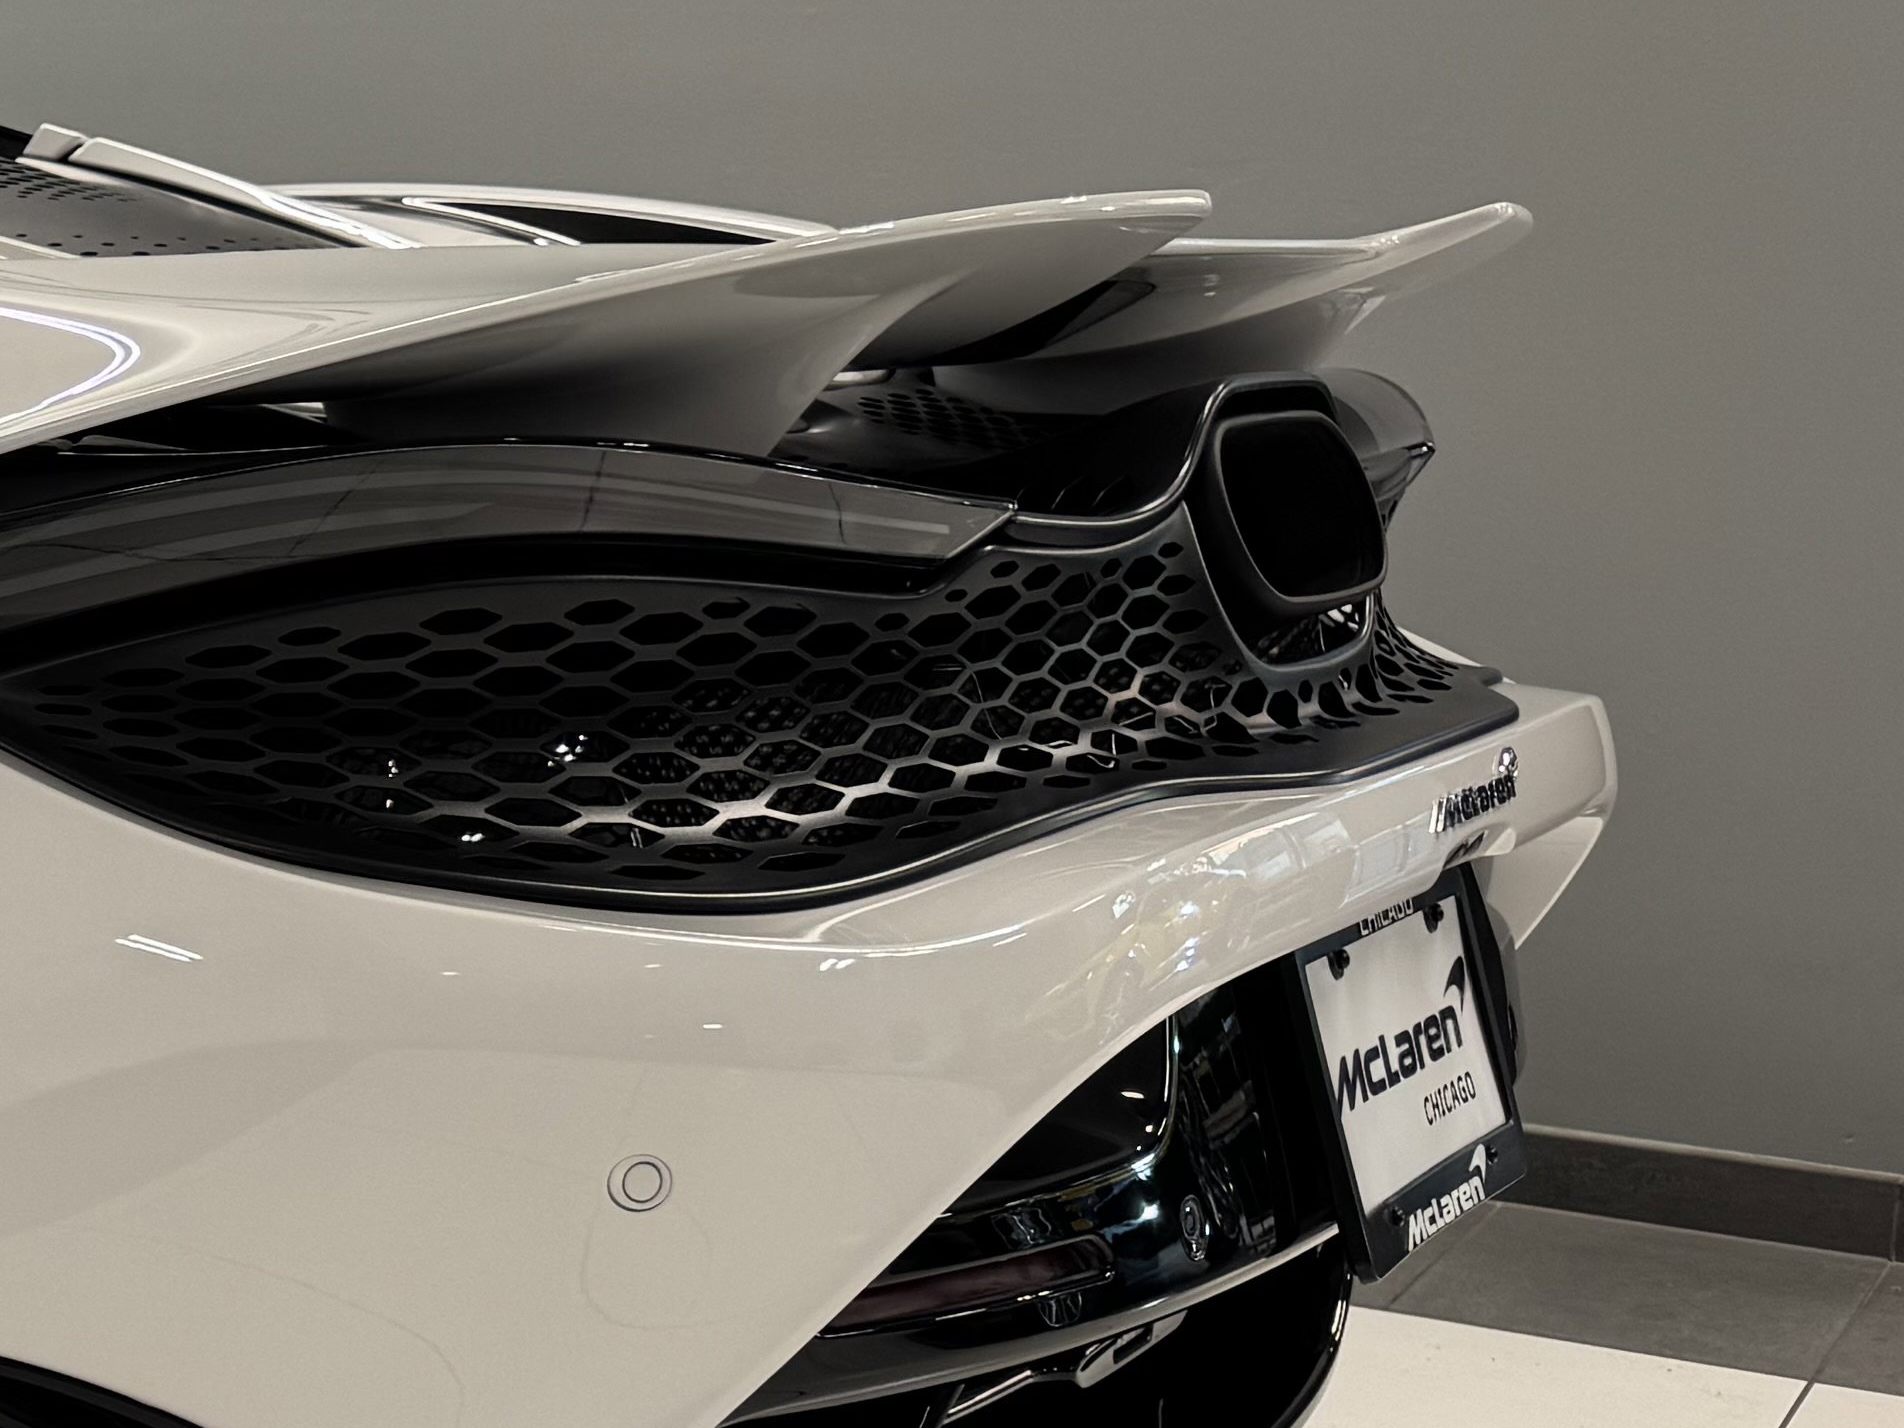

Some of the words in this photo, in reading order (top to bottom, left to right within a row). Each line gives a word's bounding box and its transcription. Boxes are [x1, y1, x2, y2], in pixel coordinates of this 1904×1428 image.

[1428, 774, 1517, 834] McLaren
[1336, 1003, 1464, 1113] McLaren
[1423, 1070, 1477, 1126] CHICAGO
[1407, 1174, 1487, 1252] McLaren
